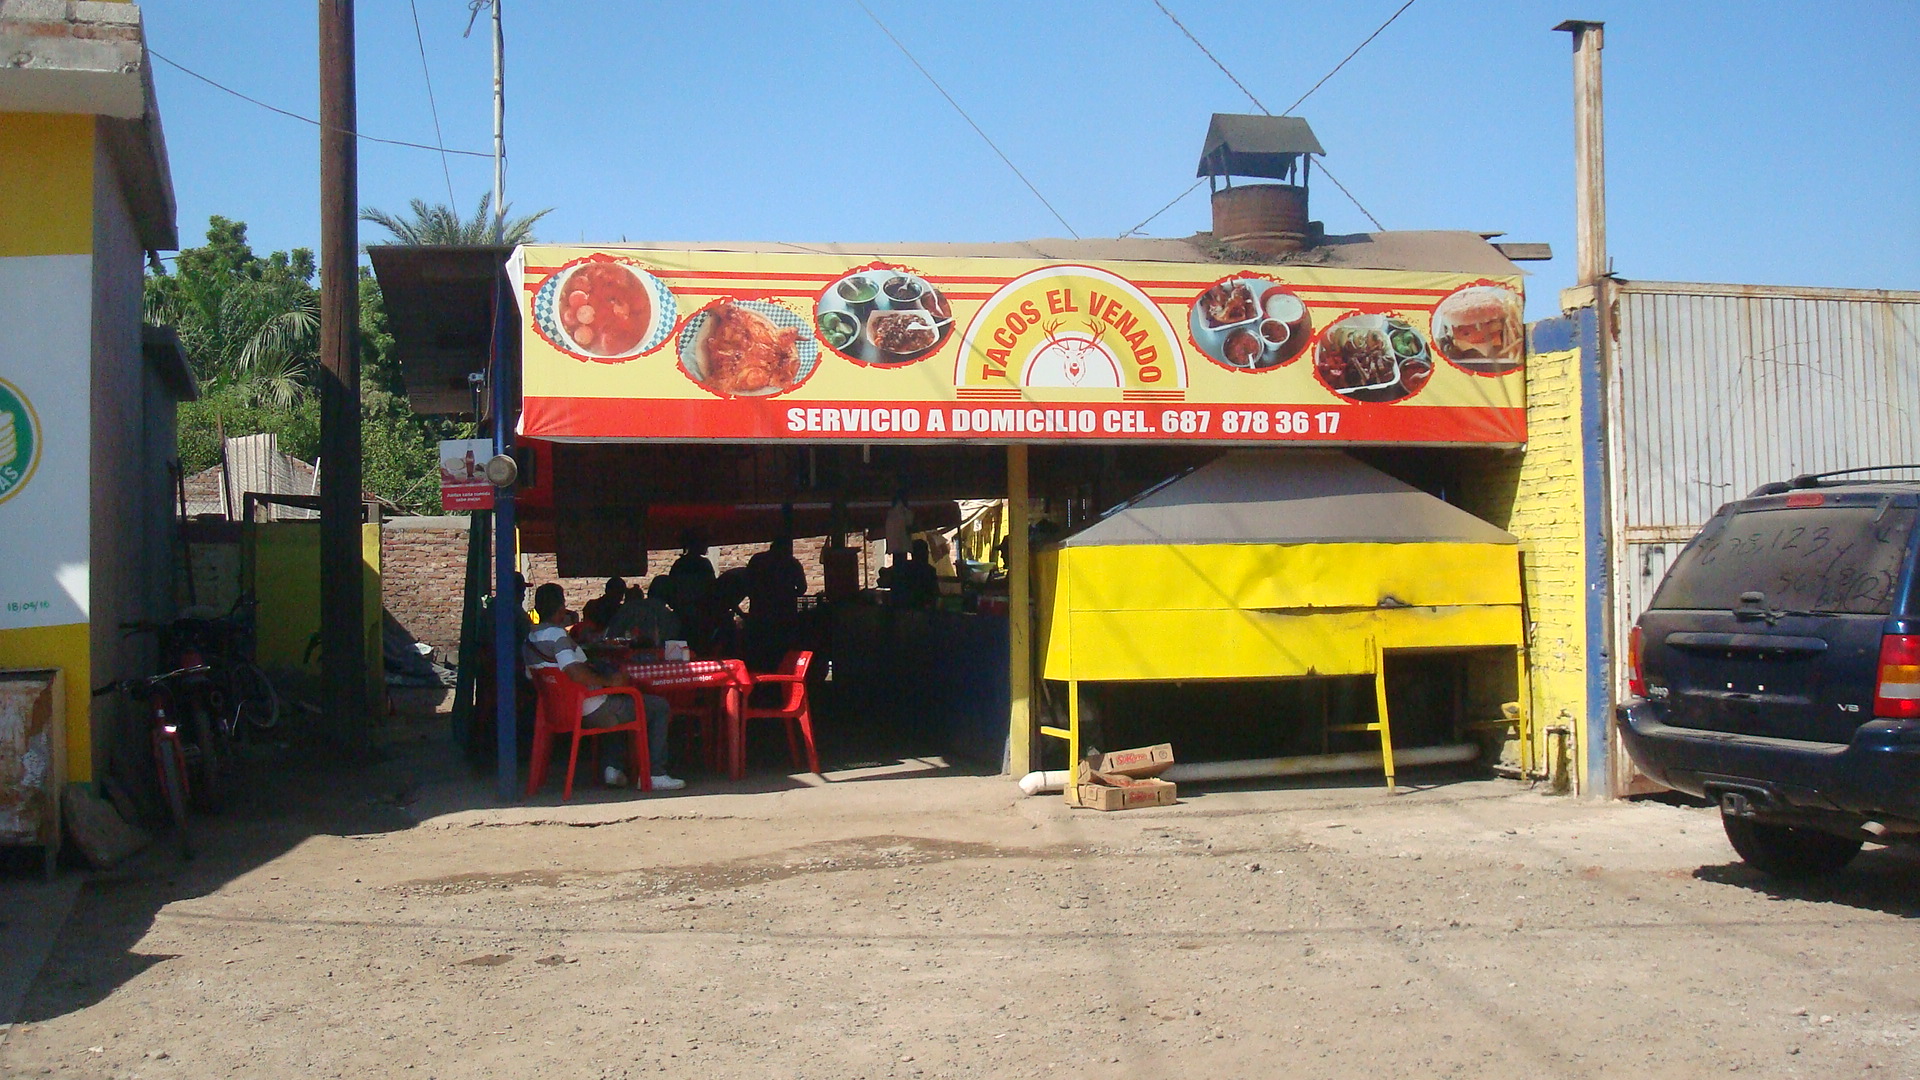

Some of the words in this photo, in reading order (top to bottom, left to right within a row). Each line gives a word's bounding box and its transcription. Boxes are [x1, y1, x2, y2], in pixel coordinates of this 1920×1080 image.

[982, 299, 1042, 380] TACOS
[1046, 288, 1079, 315] EL
[1089, 290, 1162, 383] VENADO
[787, 408, 920, 432] SERVICIO
[926, 409, 946, 432] A
[952, 409, 1096, 433] DOMICILIO
[1103, 410, 1155, 433] CEL.
[1161, 410, 1210, 433] 687
[1222, 411, 1269, 434] 878
[1275, 412, 1309, 434] 36
[1314, 412, 1340, 434] 17
